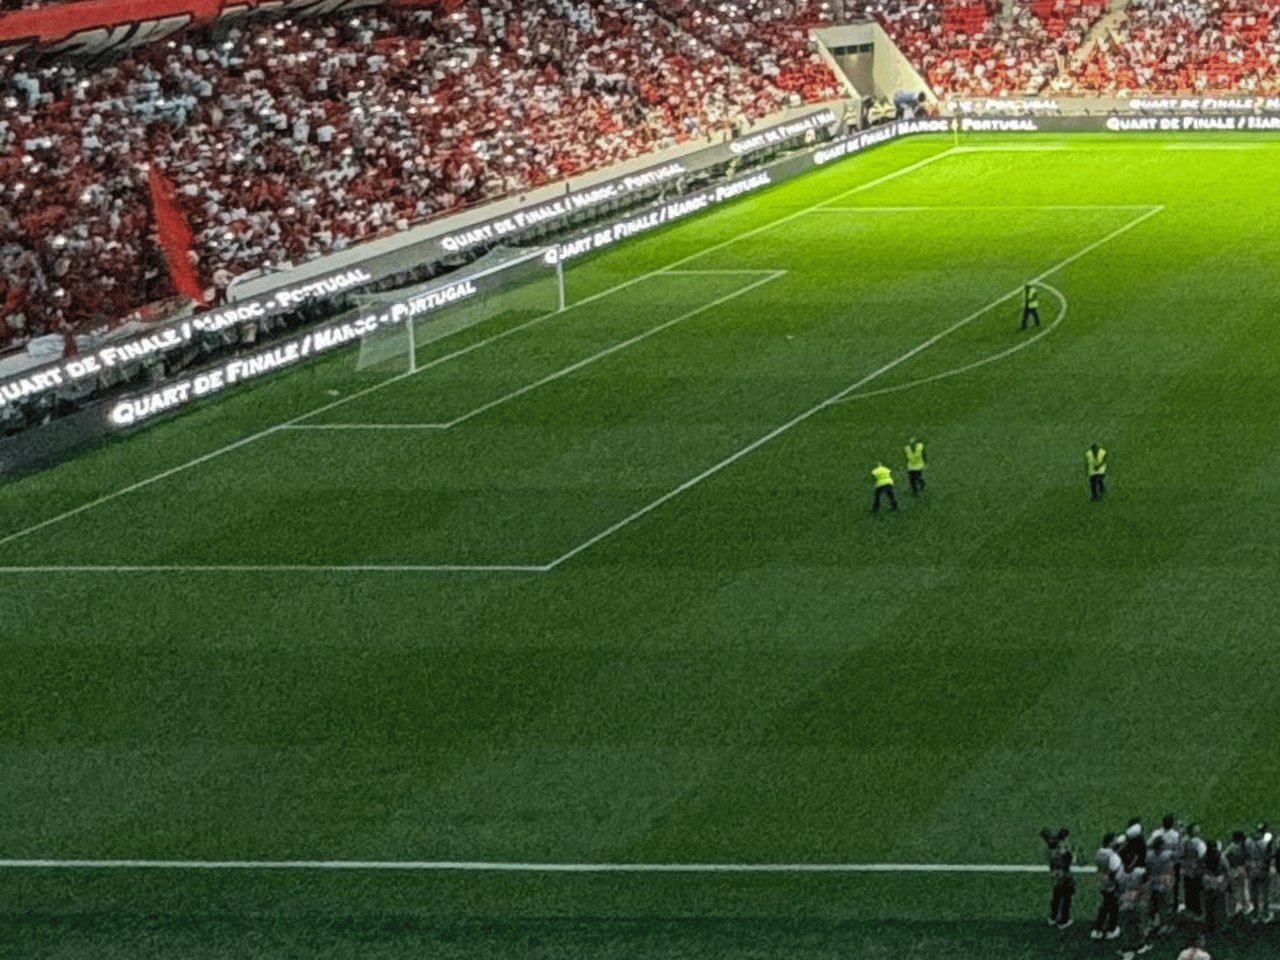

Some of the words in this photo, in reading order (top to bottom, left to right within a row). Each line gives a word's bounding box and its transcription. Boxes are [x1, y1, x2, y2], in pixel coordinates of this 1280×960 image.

[0, 368, 62, 406] UART
[100, 329, 182, 367] FINALE
[112, 383, 190, 424] QUART
[227, 345, 299, 383] FINALE
